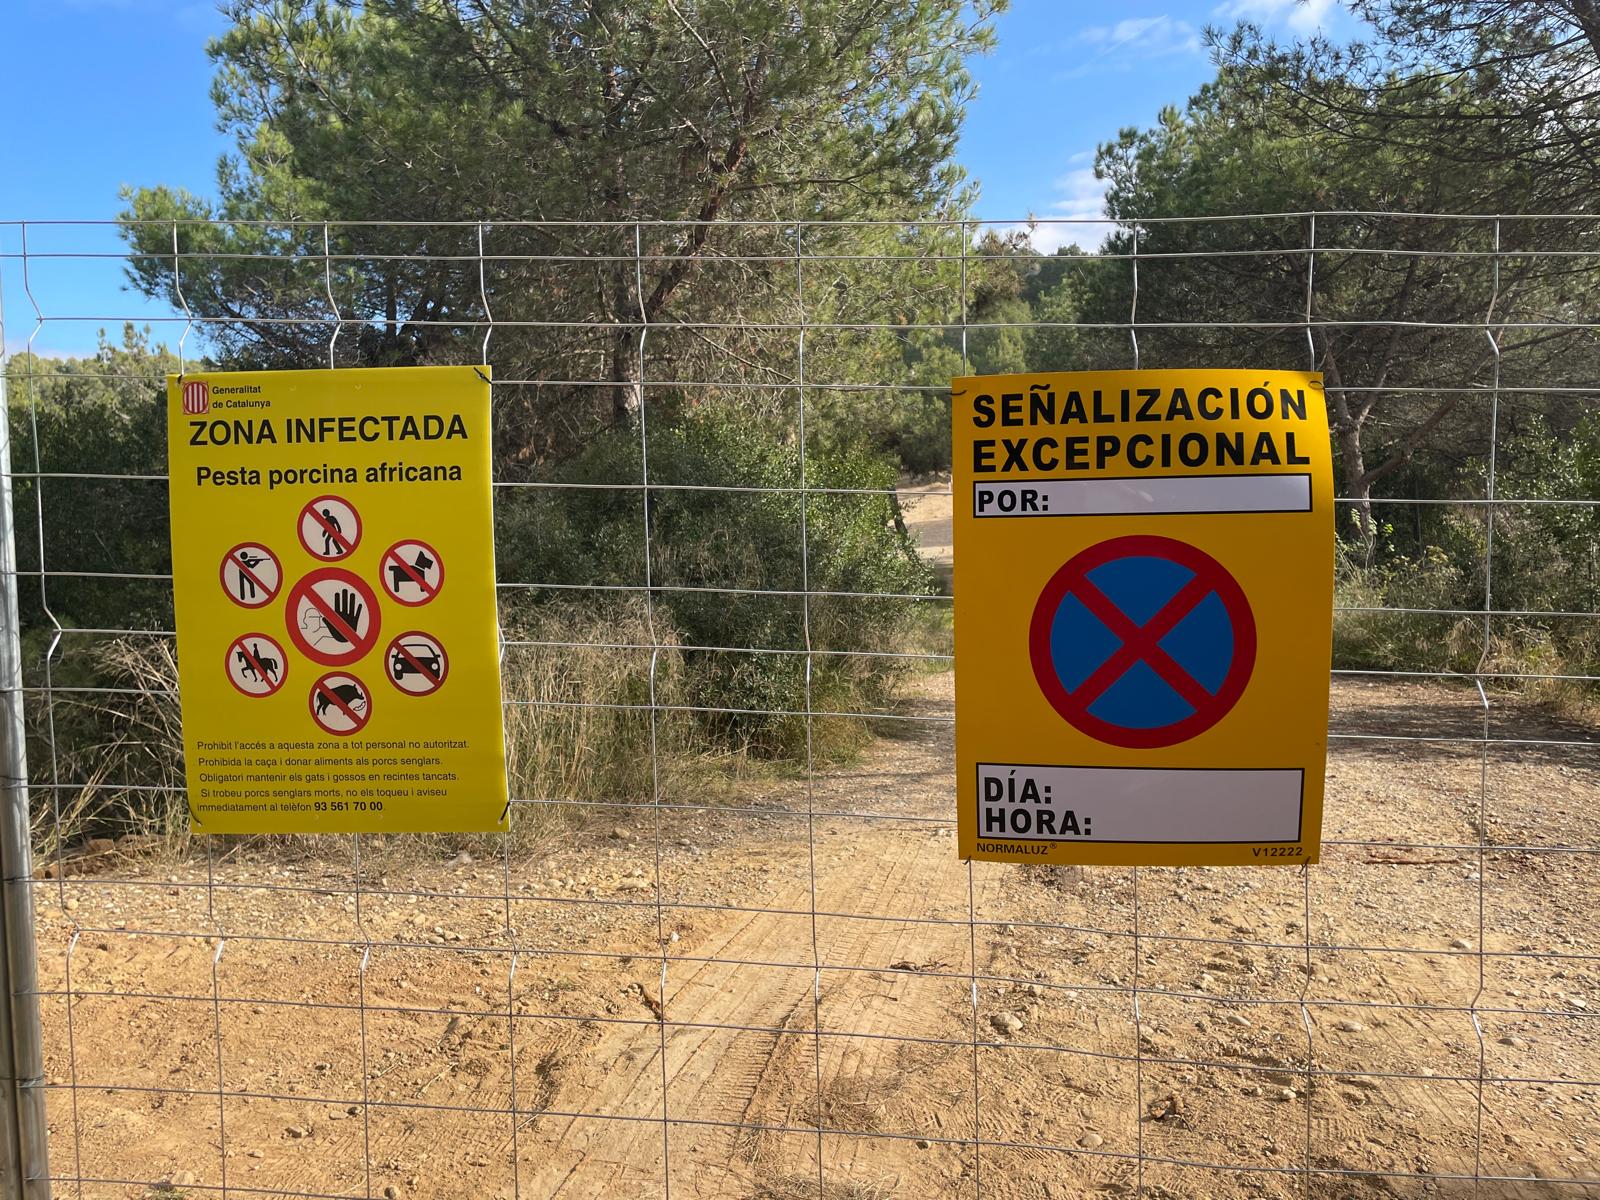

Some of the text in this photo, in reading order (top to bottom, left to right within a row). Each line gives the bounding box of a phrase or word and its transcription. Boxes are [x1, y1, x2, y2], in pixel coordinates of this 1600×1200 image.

[212, 385, 262, 395] Generalitat
[212, 399, 271, 410] de Catalunya
[972, 381, 1307, 428] SEÑALIZACIÓN
[189, 414, 468, 446] ZONA INFECTADA
[973, 432, 1311, 473] EXCEPCIONAL
[196, 462, 462, 489] Pesta porcina africana
[977, 489, 1049, 513] POR:
[197, 741, 232, 750] Prohibit
[277, 741, 314, 752] aquesta
[317, 742, 340, 750] zona
[351, 740, 363, 749] tot
[366, 740, 406, 751] personal
[423, 740, 470, 749] autoritzat.
[198, 757, 242, 766] Prohibida
[244, 757, 252, 766] la
[255, 758, 277, 768] caça
[285, 757, 312, 766] donar
[314, 757, 353, 766] aliments
[356, 757, 369, 766] als
[372, 758, 398, 767] porcs
[400, 757, 443, 767] senglars.
[199, 773, 244, 783] Obligatori
[246, 773, 287, 782] mantenir
[289, 773, 303, 781] els
[305, 774, 325, 783] gats
[332, 774, 365, 783] gossos
[383, 773, 420, 781] recintes
[422, 772, 459, 781] tancats.
[201, 789, 210, 798] Si
[213, 789, 242, 798] trobeu
[244, 790, 270, 799] porcs
[272, 788, 311, 799] senglars
[314, 788, 343, 799] morts,
[346, 789, 358, 797] no
[360, 787, 374, 797] els
[376, 788, 409, 798] toqueu
[416, 787, 447, 797] aviseu
[984, 770, 1052, 804] DÍA:
[197, 803, 267, 812] immediatament
[269, 803, 278, 811] al
[280, 802, 311, 811] telèfon
[314, 801, 327, 811] 93
[330, 801, 349, 811] 561
[353, 801, 367, 811] 70
[985, 807, 1092, 836] HORA:
[1252, 847, 1303, 858] V12222
